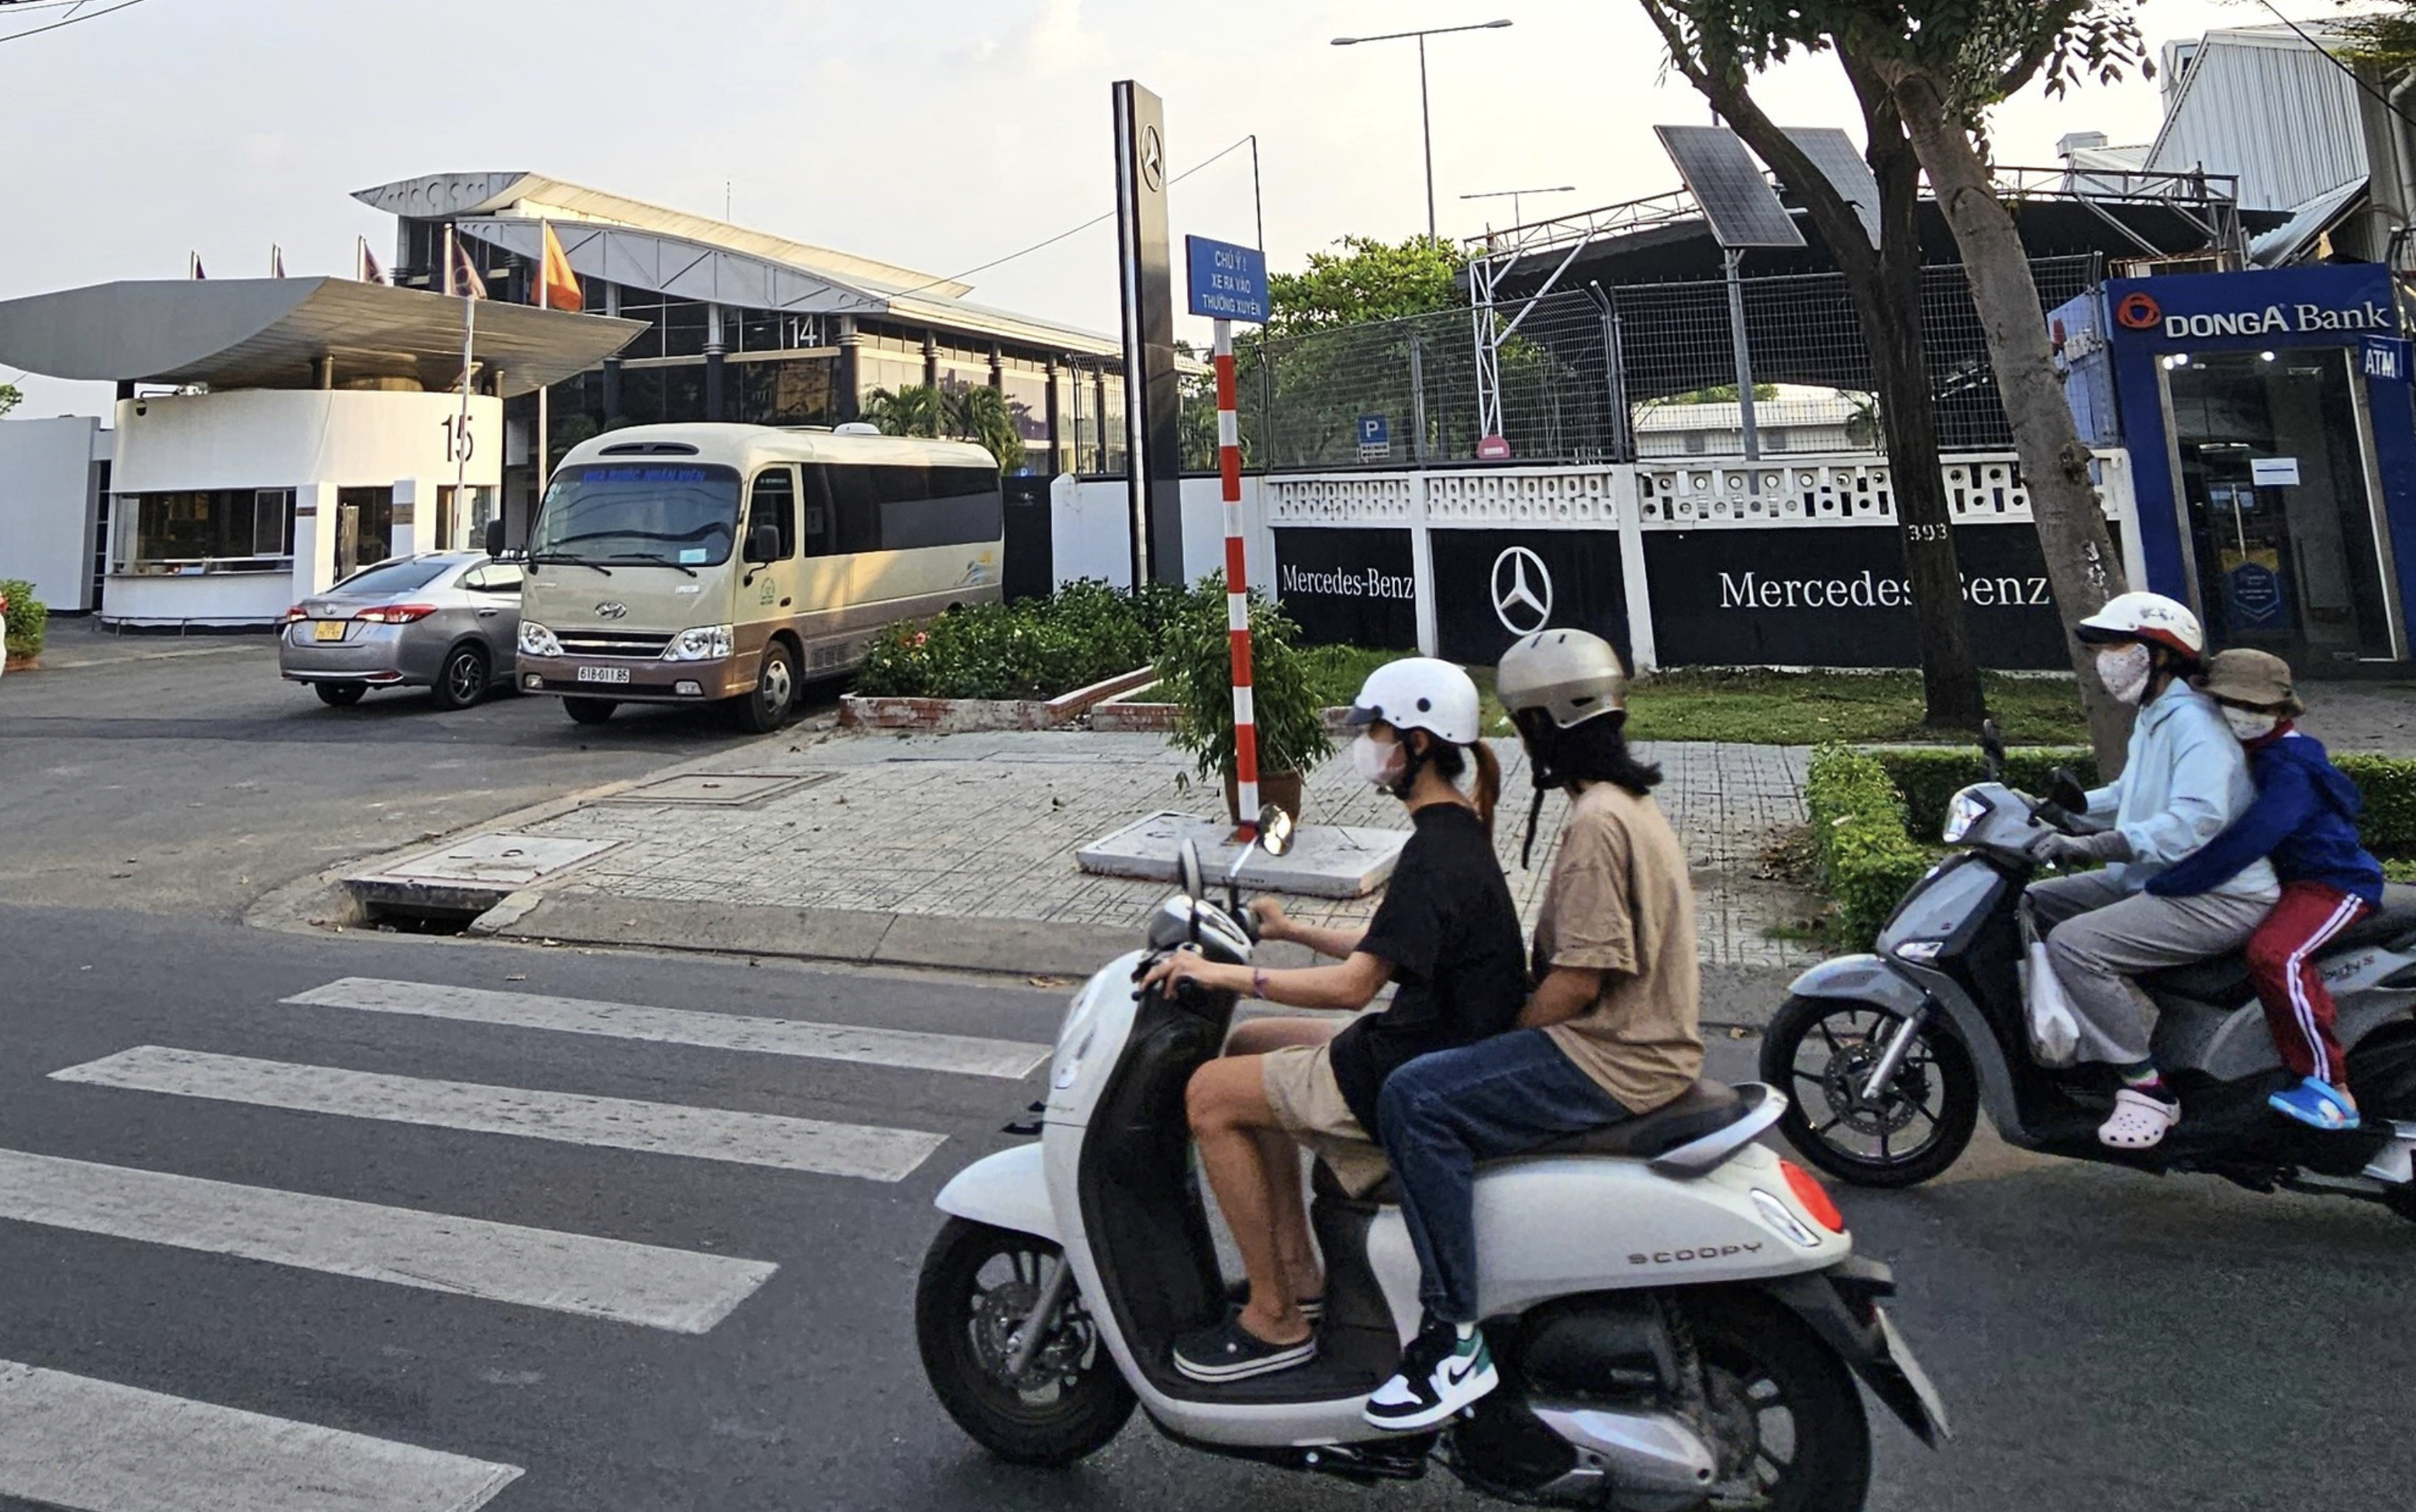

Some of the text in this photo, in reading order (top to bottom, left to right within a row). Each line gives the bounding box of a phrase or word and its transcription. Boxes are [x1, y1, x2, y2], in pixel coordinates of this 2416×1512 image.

[1215, 249, 1234, 270] CHÚ
[1211, 273, 1251, 294] XE RA VÀO
[1235, 298, 1261, 316] XUYÊN
[2293, 300, 2392, 332] Bank
[789, 314, 817, 348] 14
[2365, 348, 2395, 378] ATM
[440, 414, 474, 462] 15
[1365, 420, 1379, 438] P
[1282, 564, 1413, 599] Mercedes-Benz
[1627, 1242, 1762, 1265] SCOOPY
